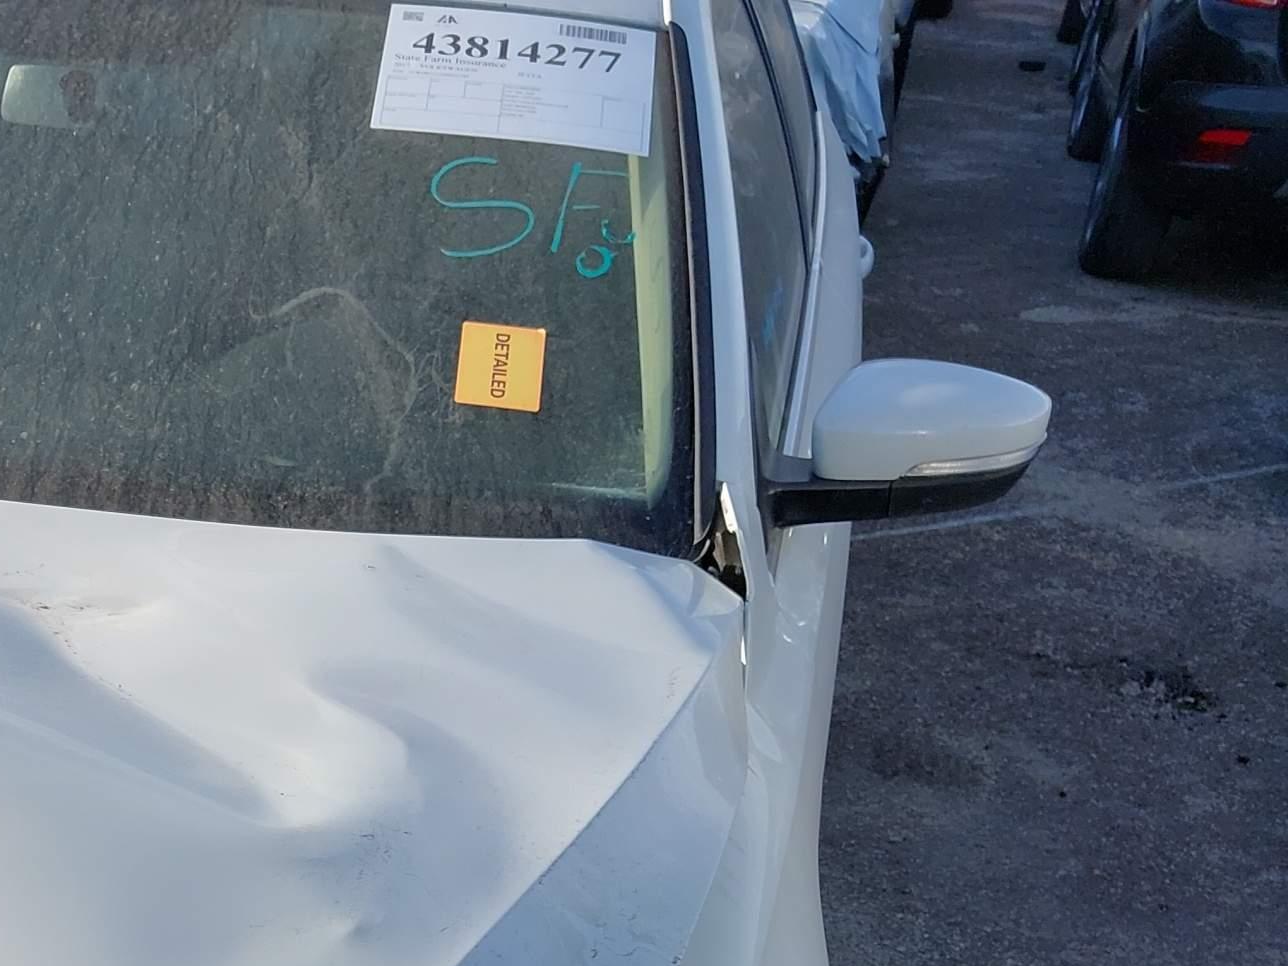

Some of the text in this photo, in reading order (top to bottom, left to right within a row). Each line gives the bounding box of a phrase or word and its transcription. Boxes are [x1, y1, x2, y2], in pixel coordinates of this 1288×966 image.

[394, 53, 421, 62] State
[424, 55, 452, 64] Farm
[455, 58, 508, 69] Insurance
[412, 31, 622, 73] 43814277
[489, 332, 511, 399] DETAILED
